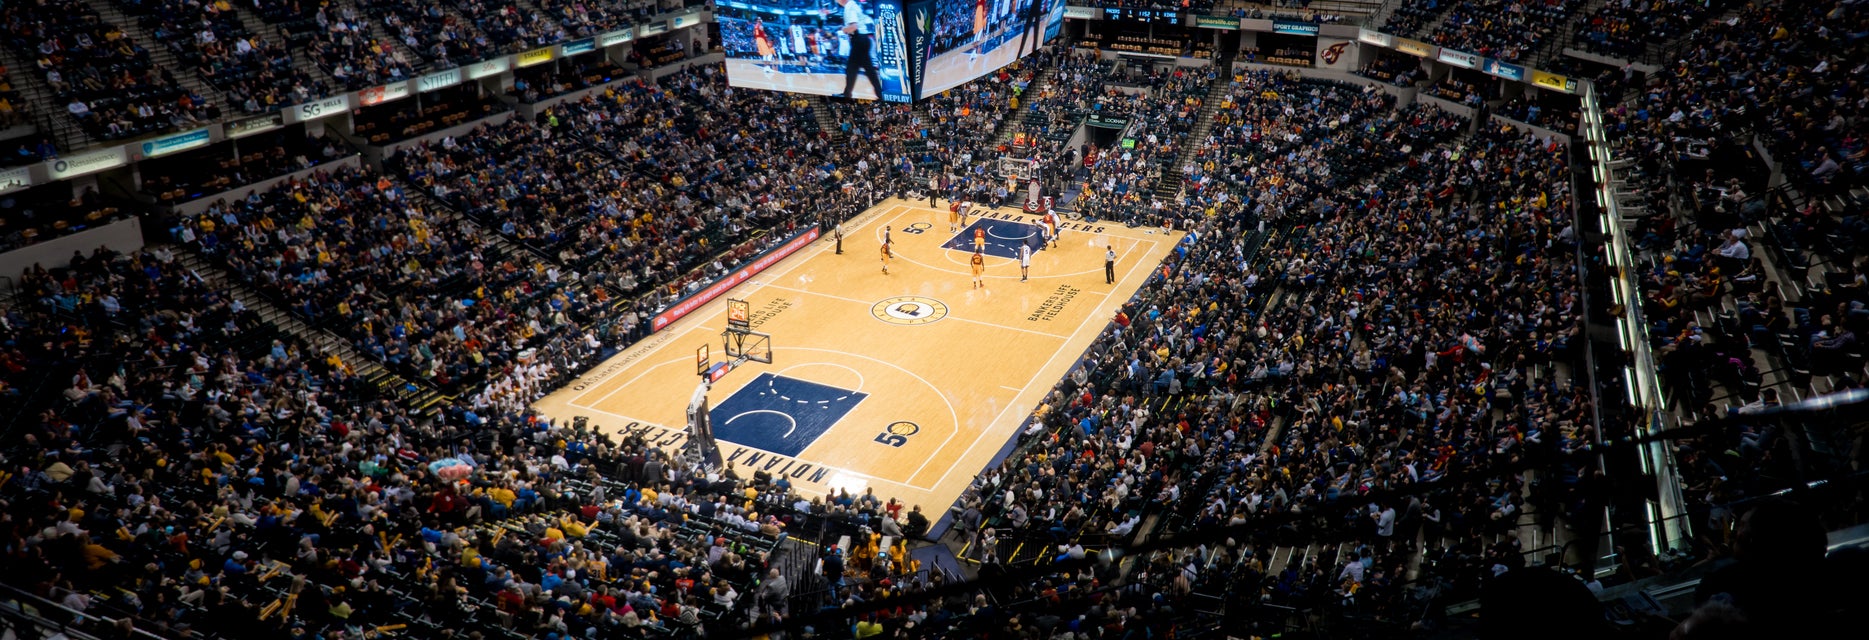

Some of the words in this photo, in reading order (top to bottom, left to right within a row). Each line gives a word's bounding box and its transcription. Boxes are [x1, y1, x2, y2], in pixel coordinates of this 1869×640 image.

[915, 49, 924, 85] Vincent
[883, 93, 910, 103] REPLAY
[764, 298, 785, 311] LIFE
[1028, 296, 1059, 321] BANKERS
[1053, 284, 1071, 296] LIFE
[1042, 288, 1081, 321] FIELDHOUSE
[874, 421, 920, 448] 50
